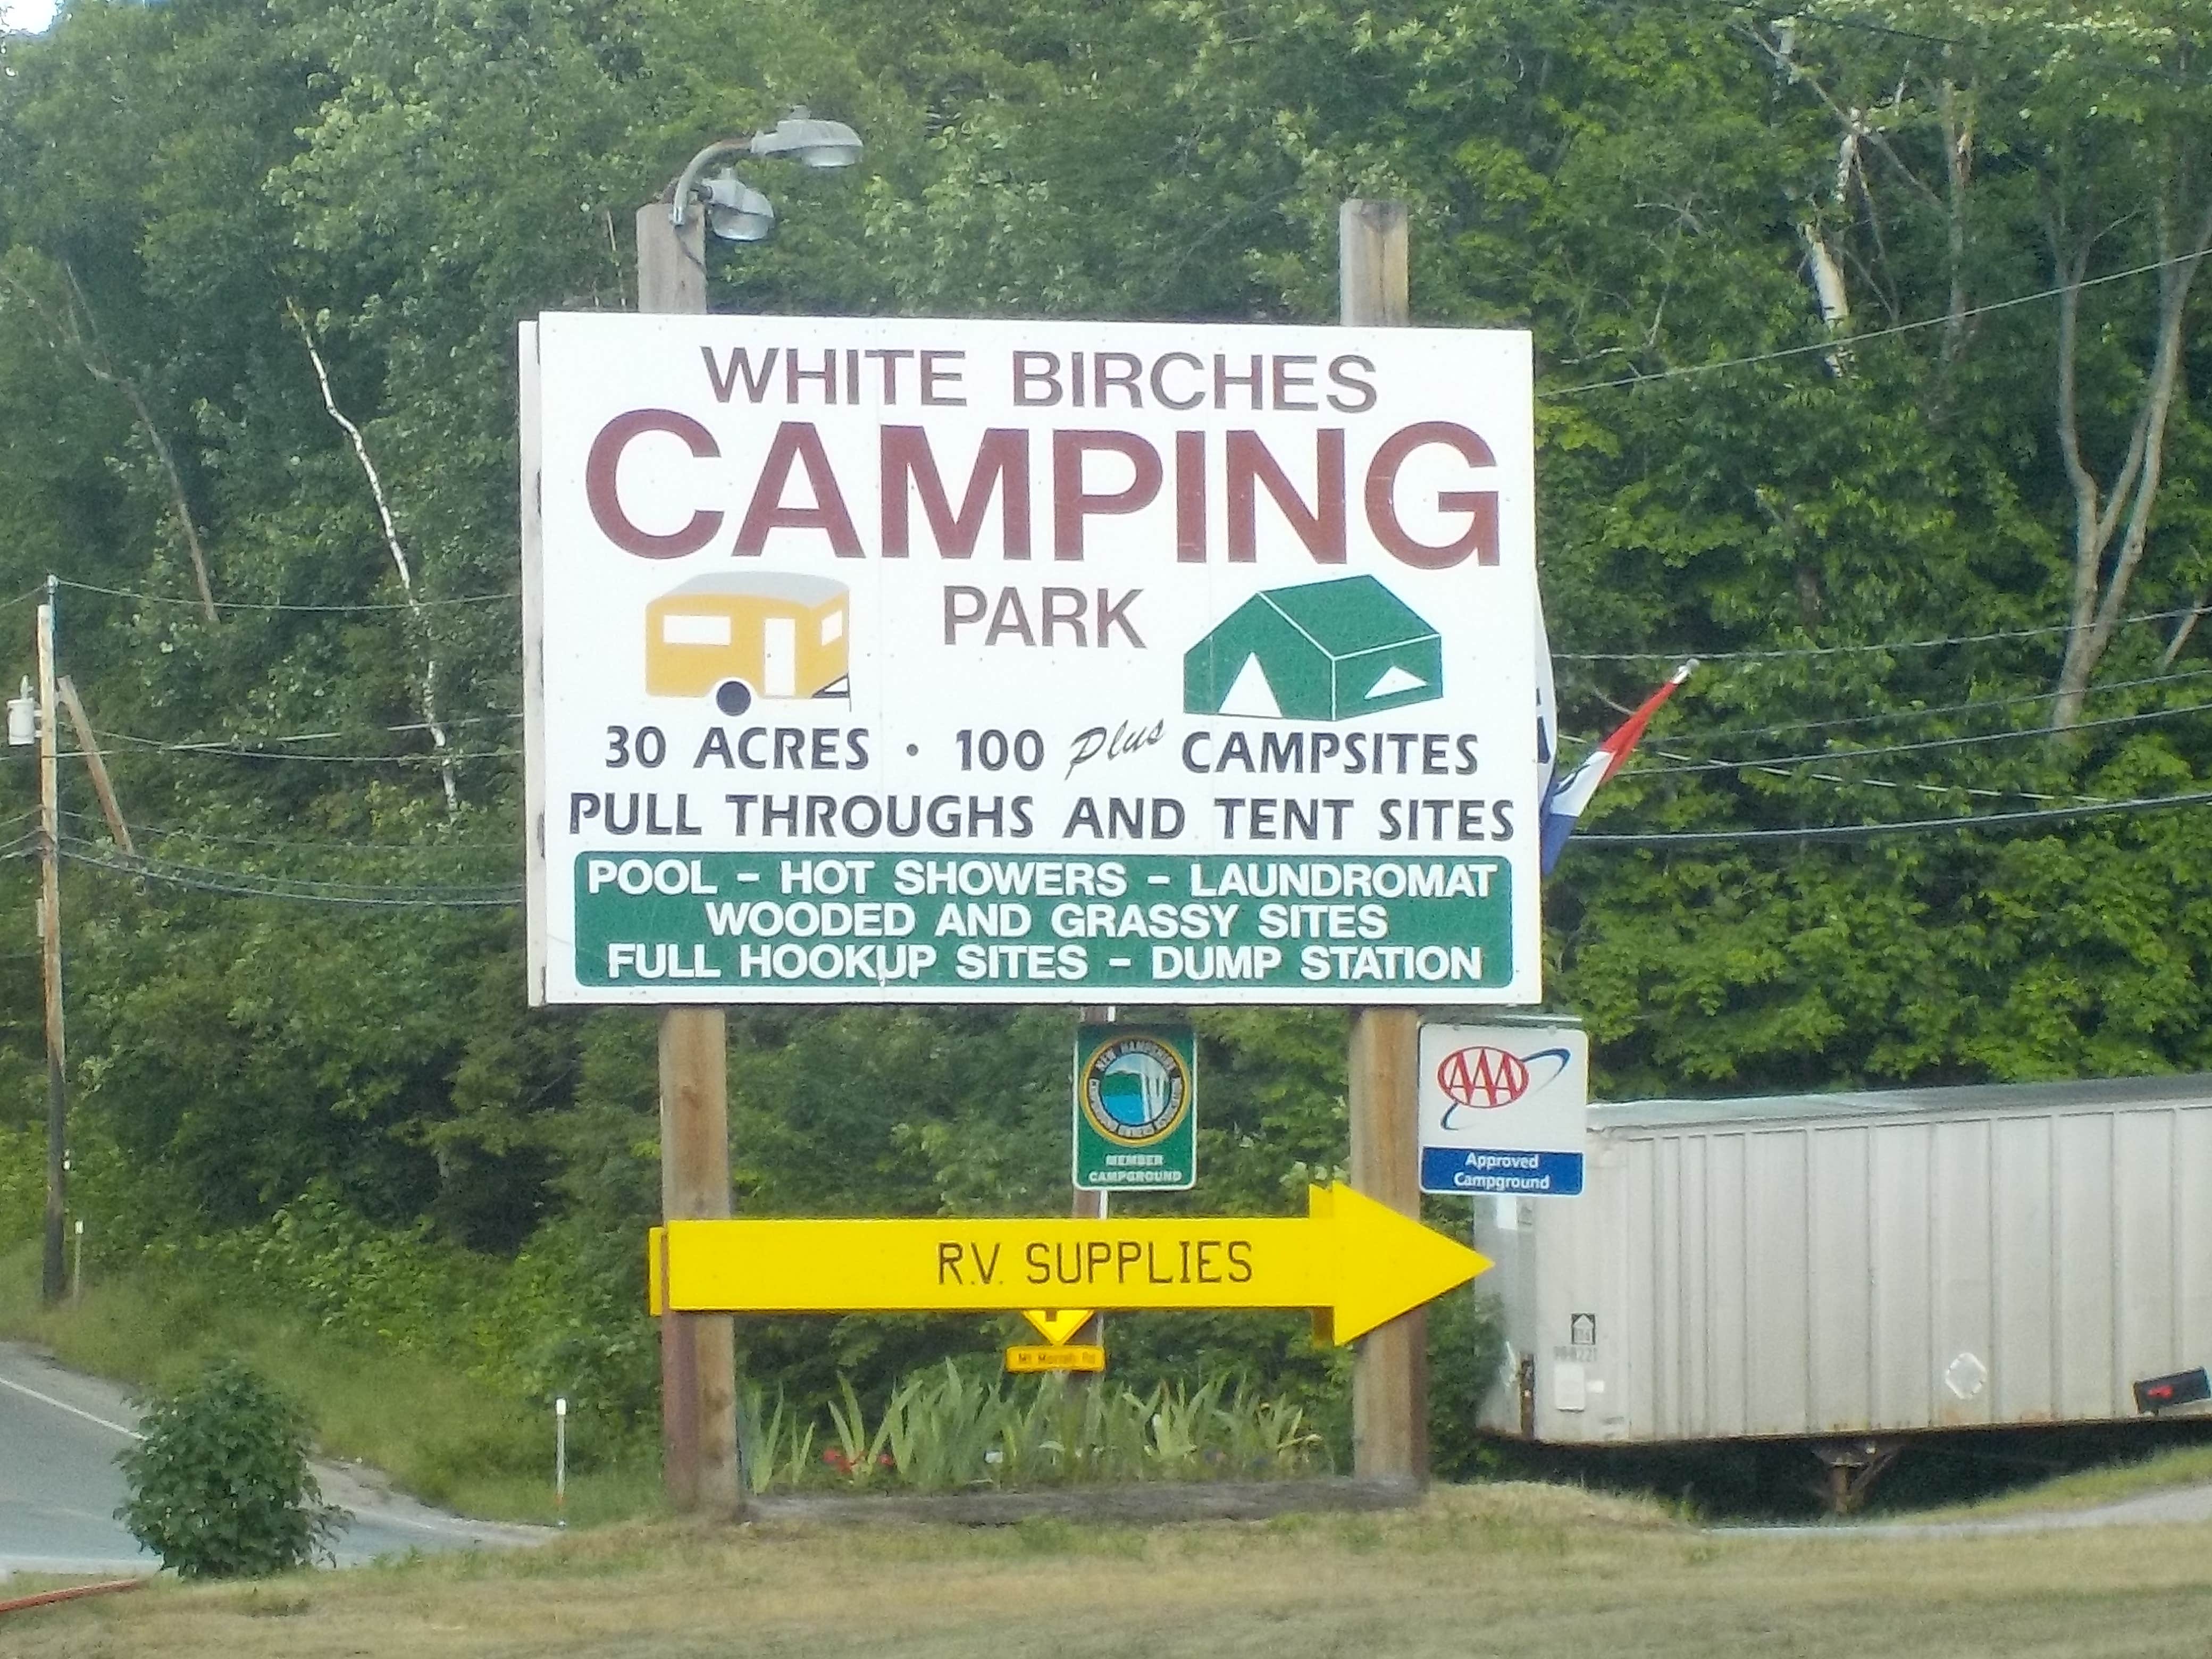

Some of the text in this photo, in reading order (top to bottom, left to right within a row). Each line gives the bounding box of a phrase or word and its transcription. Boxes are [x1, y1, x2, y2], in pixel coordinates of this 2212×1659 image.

[701, 346, 1377, 413] WHITE BIRCHES
[585, 408, 1500, 570] CAMPING
[944, 585, 1146, 648] PARK
[606, 719, 1478, 780] 30 ACRES 100 Plus CAMPSITES
[569, 792, 1514, 842] PULL THROUGHS AND TENT SITES
[589, 859, 718, 895] POOL
[781, 859, 875, 894] HOT
[894, 859, 1127, 897] SHOWERS
[1191, 863, 1498, 898] LAUNDROMAT
[705, 901, 1388, 939] WOODED AND GRASSY SITES
[608, 943, 721, 978] FULL
[740, 943, 937, 981] HOOKUP
[956, 944, 1088, 979] SITES
[1152, 945, 1281, 980] DUMP
[1301, 945, 1482, 981] STATION
[1438, 1046, 1529, 1108] AAA
[1089, 1171, 1183, 1183] CAMPGROUND
[1453, 1172, 1551, 1190] Campground
[1465, 1152, 1539, 1170] Approved
[939, 1241, 1252, 1285] R.V. SUPPLIES
